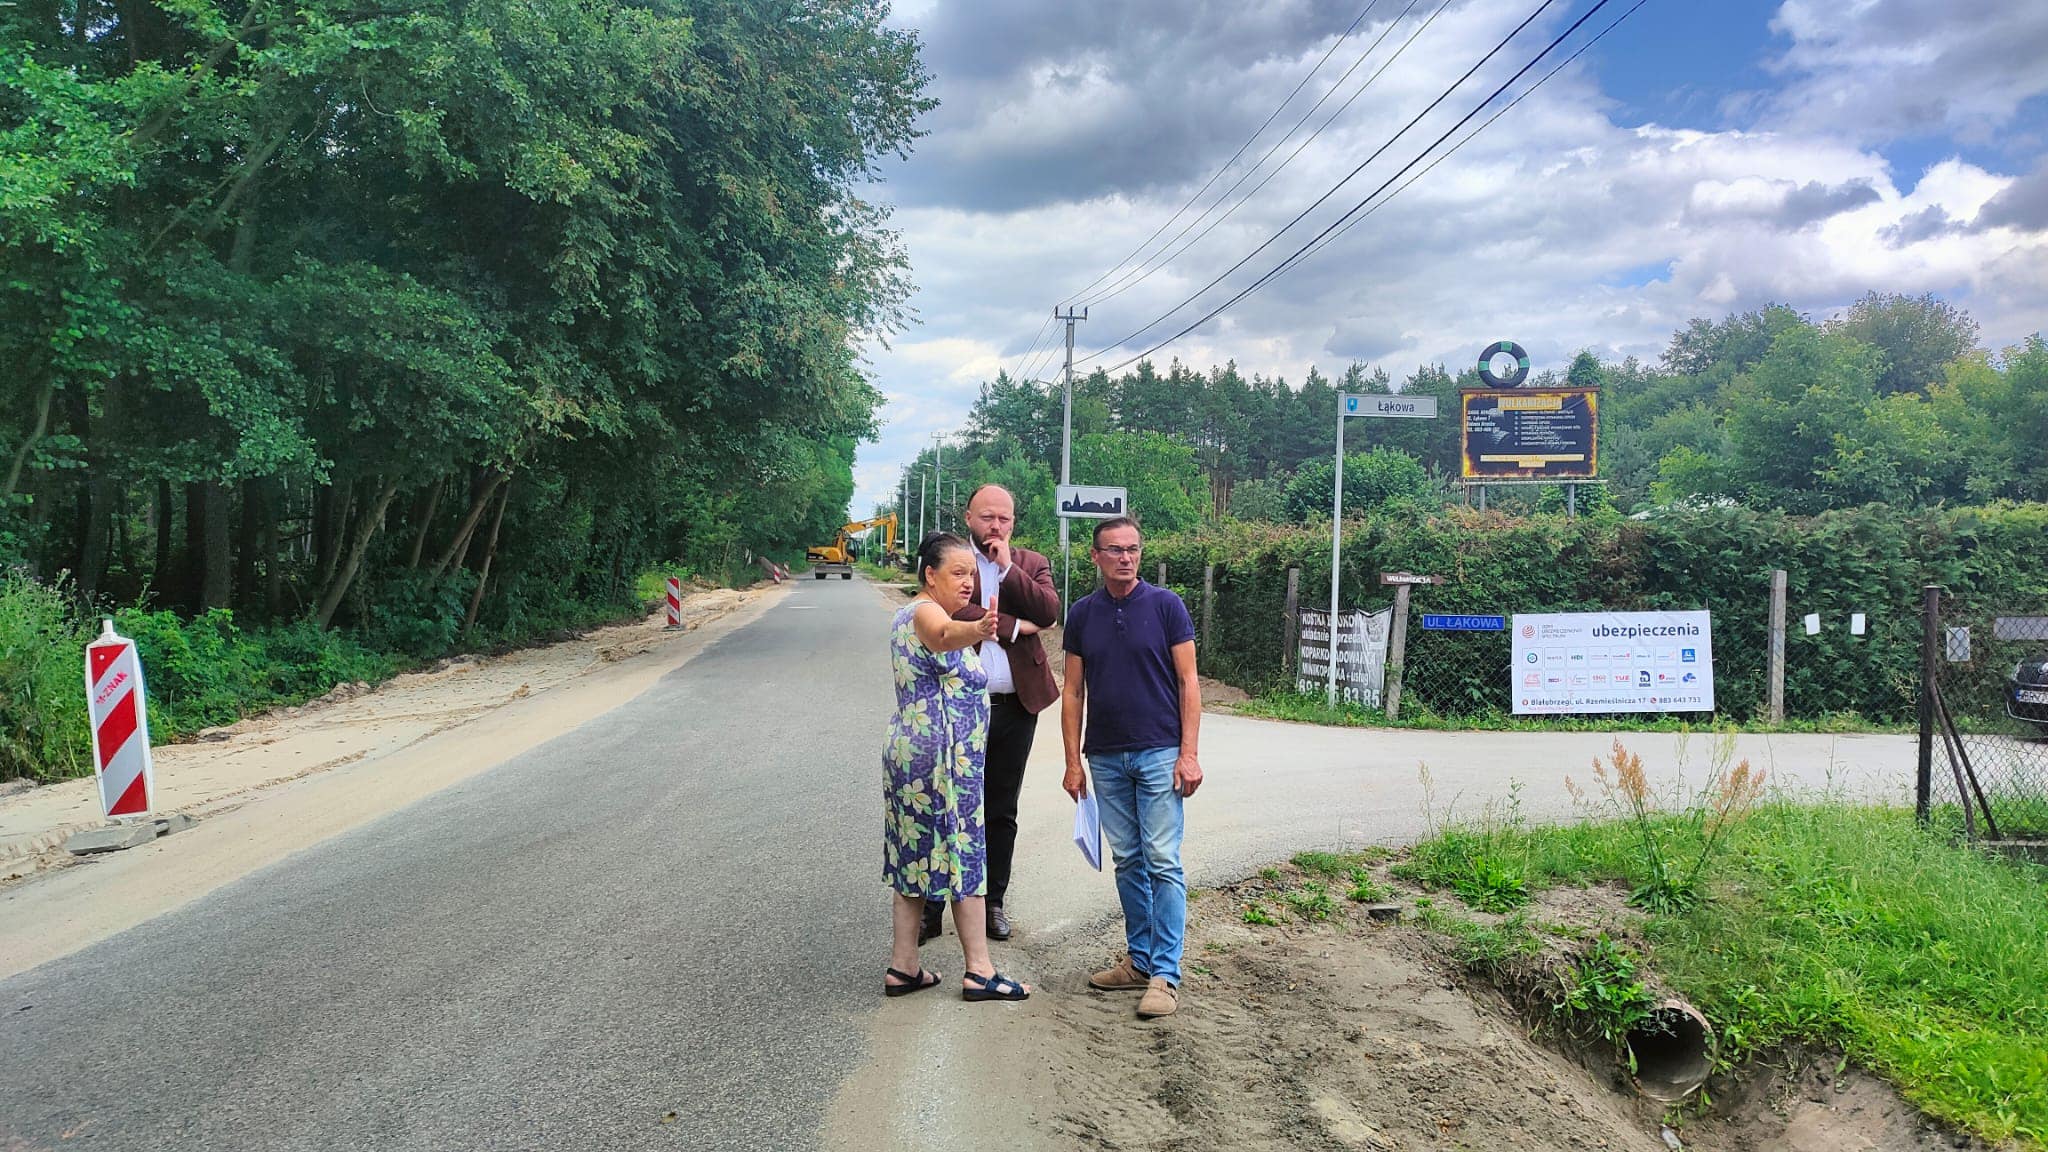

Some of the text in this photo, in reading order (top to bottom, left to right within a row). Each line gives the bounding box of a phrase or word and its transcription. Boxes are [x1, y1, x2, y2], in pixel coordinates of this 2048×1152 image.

[1378, 400, 1415, 414] Łąkowa
[1446, 617, 1500, 629] ŁĄKOWA
[1592, 623, 1700, 639] ubezpieczenia
[96, 671, 128, 704] M-ZNAK
